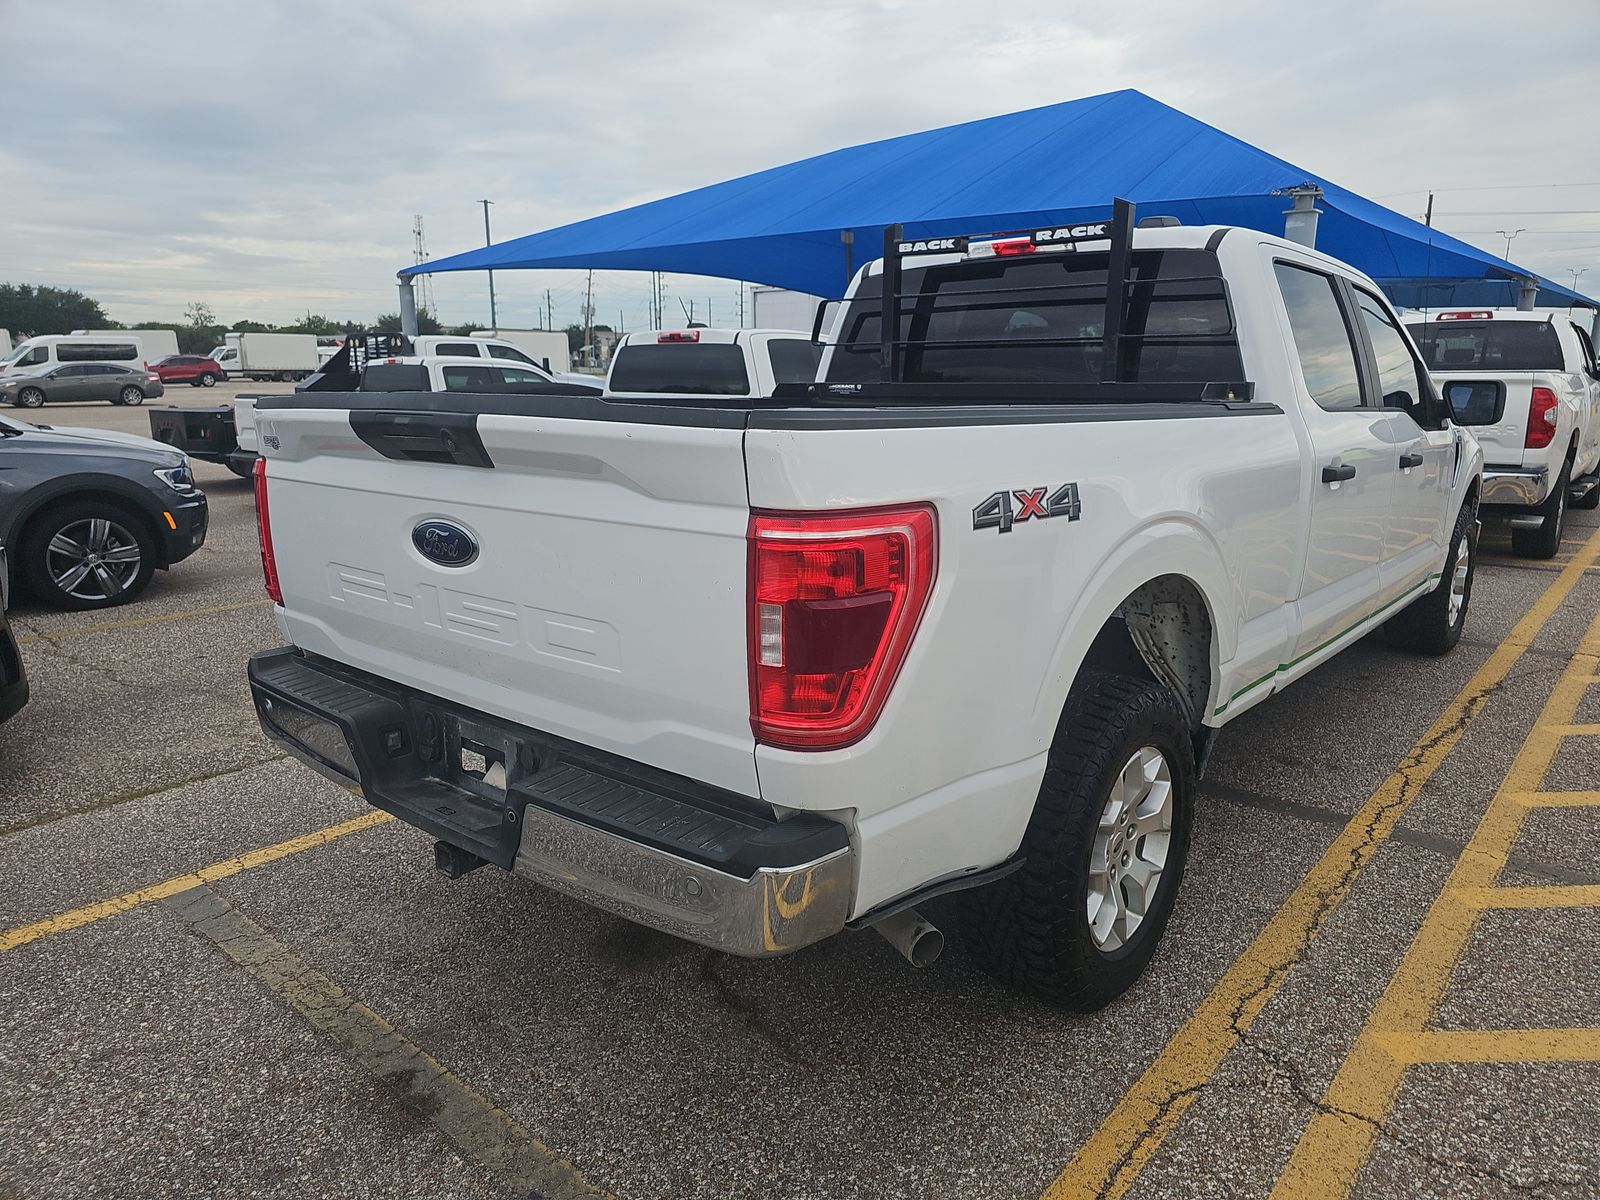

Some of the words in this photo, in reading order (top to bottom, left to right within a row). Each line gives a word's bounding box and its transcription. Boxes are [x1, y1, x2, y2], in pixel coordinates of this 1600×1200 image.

[898, 238, 956, 253] BACK
[1035, 224, 1106, 241] RACK
[326, 561, 622, 672] F-150
